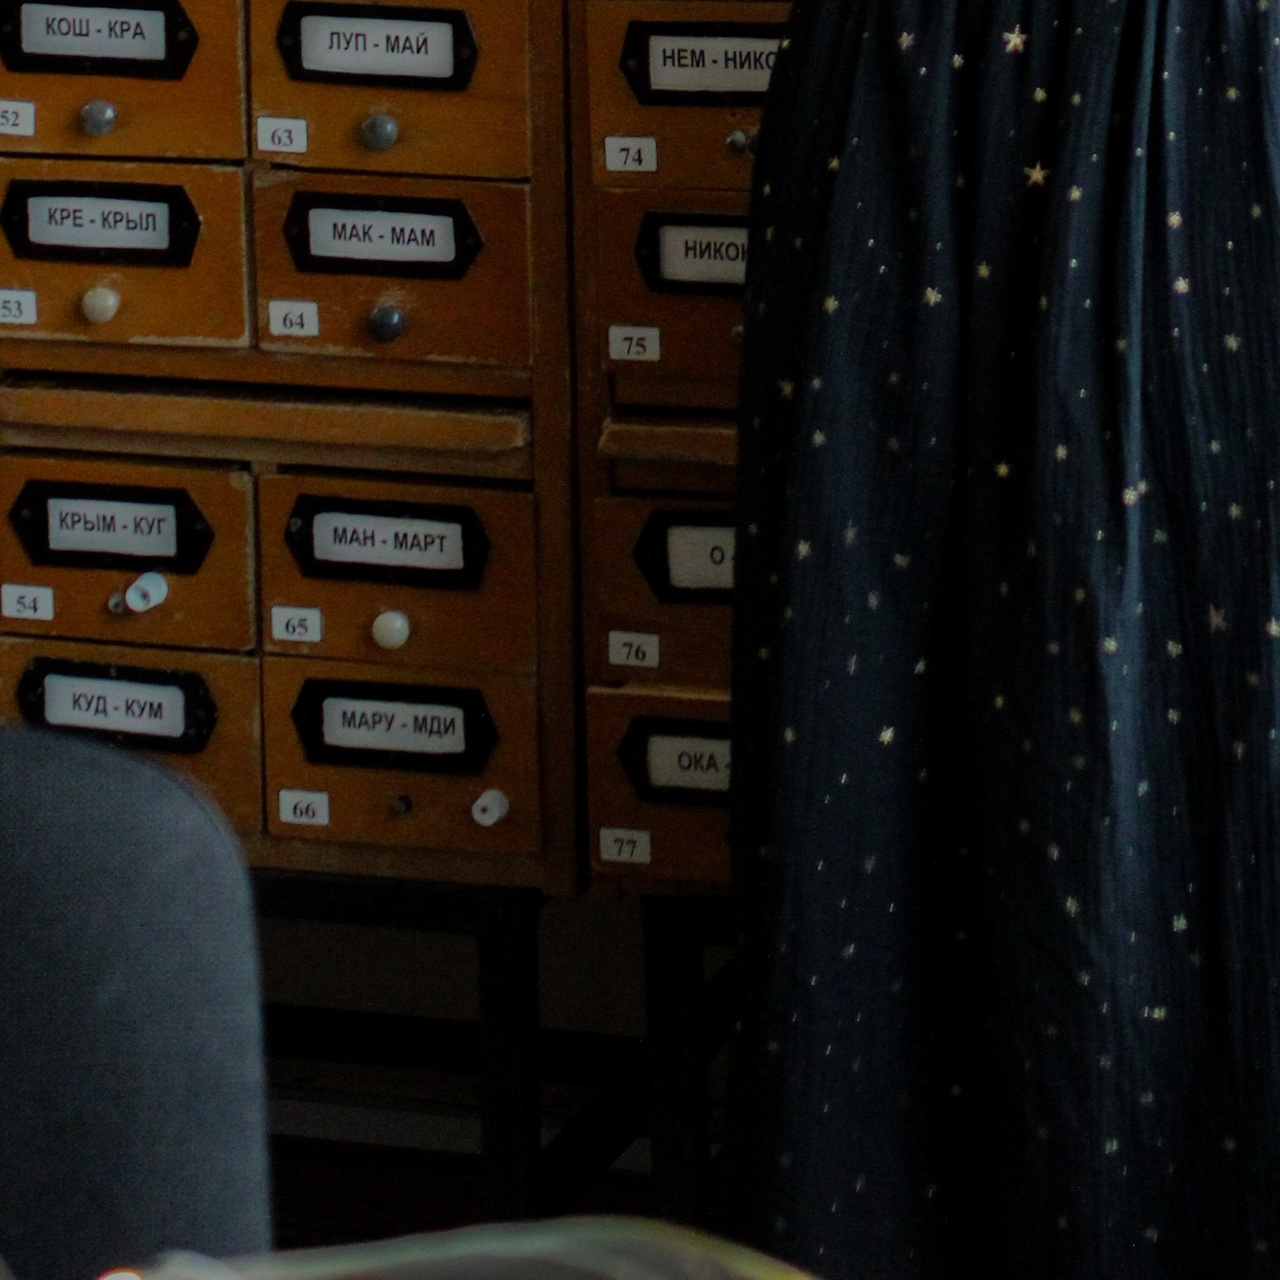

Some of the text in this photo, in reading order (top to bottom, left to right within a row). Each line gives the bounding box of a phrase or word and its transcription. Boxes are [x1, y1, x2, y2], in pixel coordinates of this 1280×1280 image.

[46, 17, 145, 39] КОШ КРА
[329, 31, 428, 54] ЛУП МАЙ
[620, 148, 643, 165] 74
[48, 208, 156, 231] КРЕ КРЫЛ
[333, 223, 435, 246] МАК МАМ
[59, 512, 166, 535] КРЫМ КУГ
[333, 527, 446, 552] МАН МАРТ
[17, 596, 38, 613] 54
[73, 694, 162, 719] КУД КУМ
[342, 711, 455, 737] МАРУ МДИ
